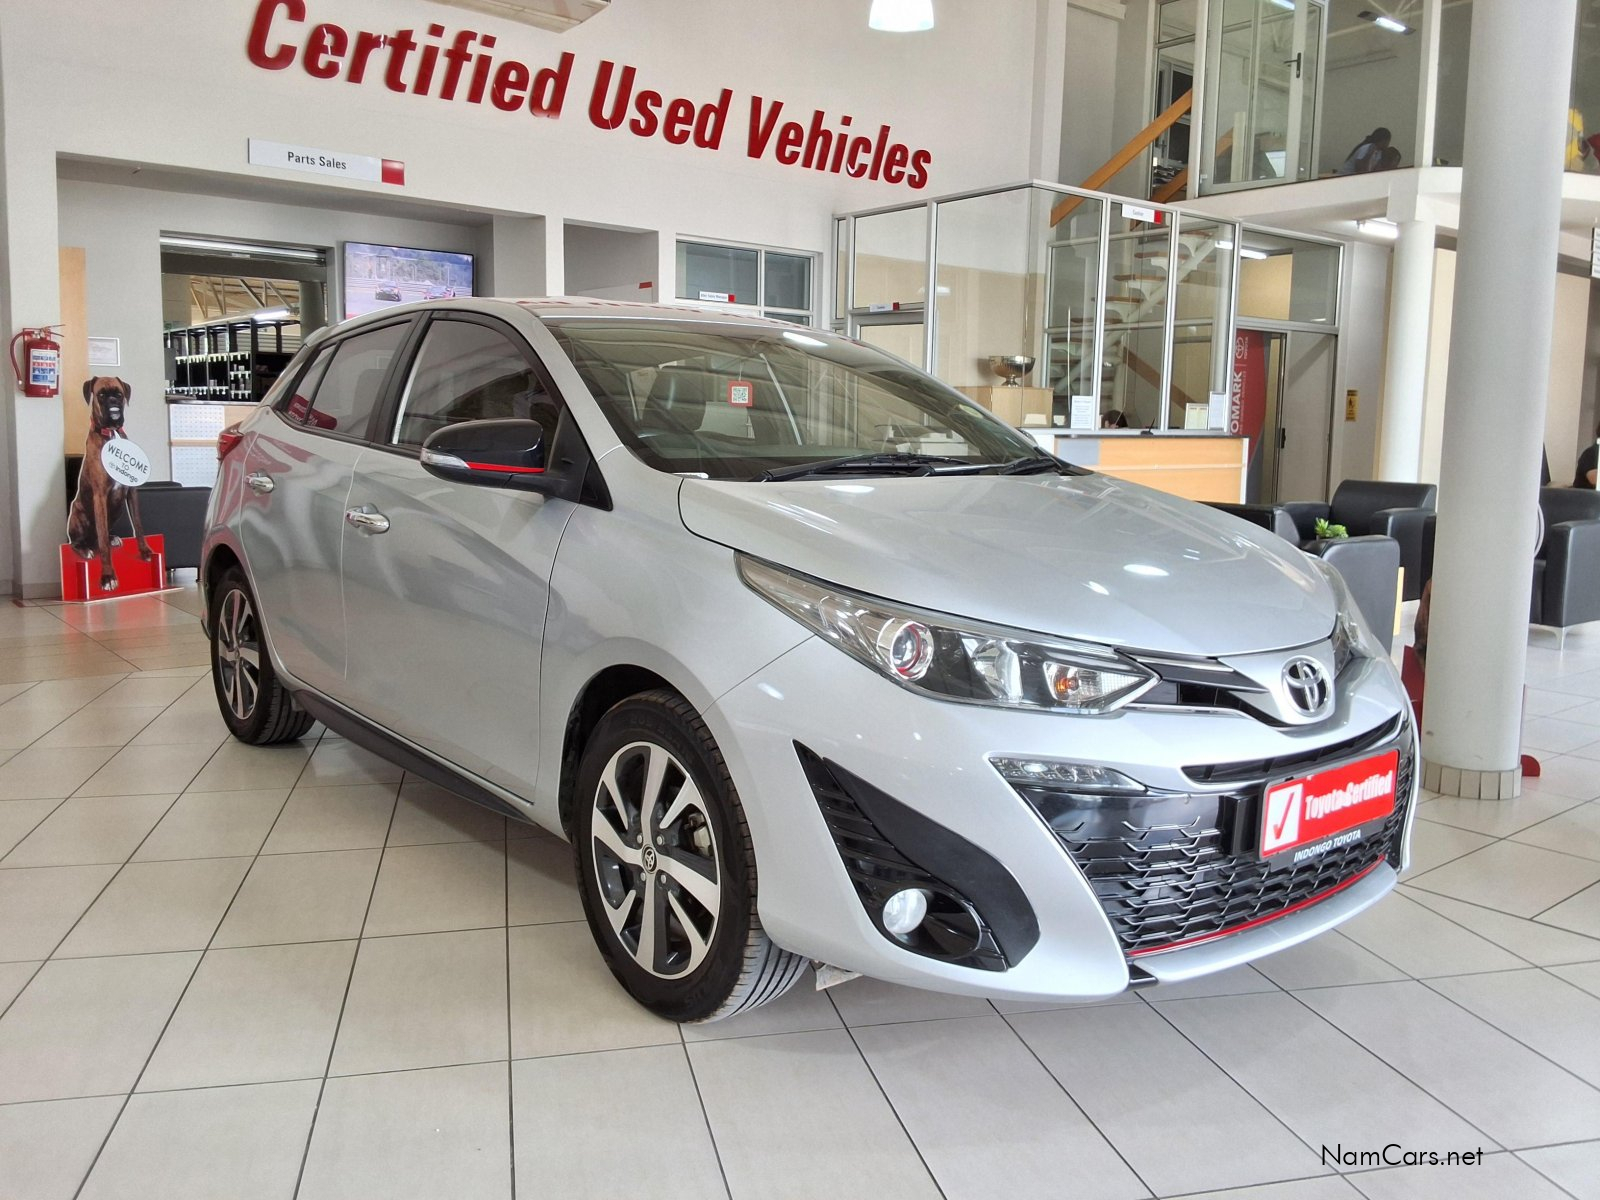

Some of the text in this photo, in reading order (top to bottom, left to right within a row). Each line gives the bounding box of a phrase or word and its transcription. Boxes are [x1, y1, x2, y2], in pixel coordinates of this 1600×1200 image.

[247, 0, 932, 189] Certified Used Vehicles
[287, 151, 347, 170] Parts Sales
[108, 443, 148, 474] WELCOME
[121, 462, 130, 471] TO
[1294, 829, 1361, 862] INDONGO TOYOTA
